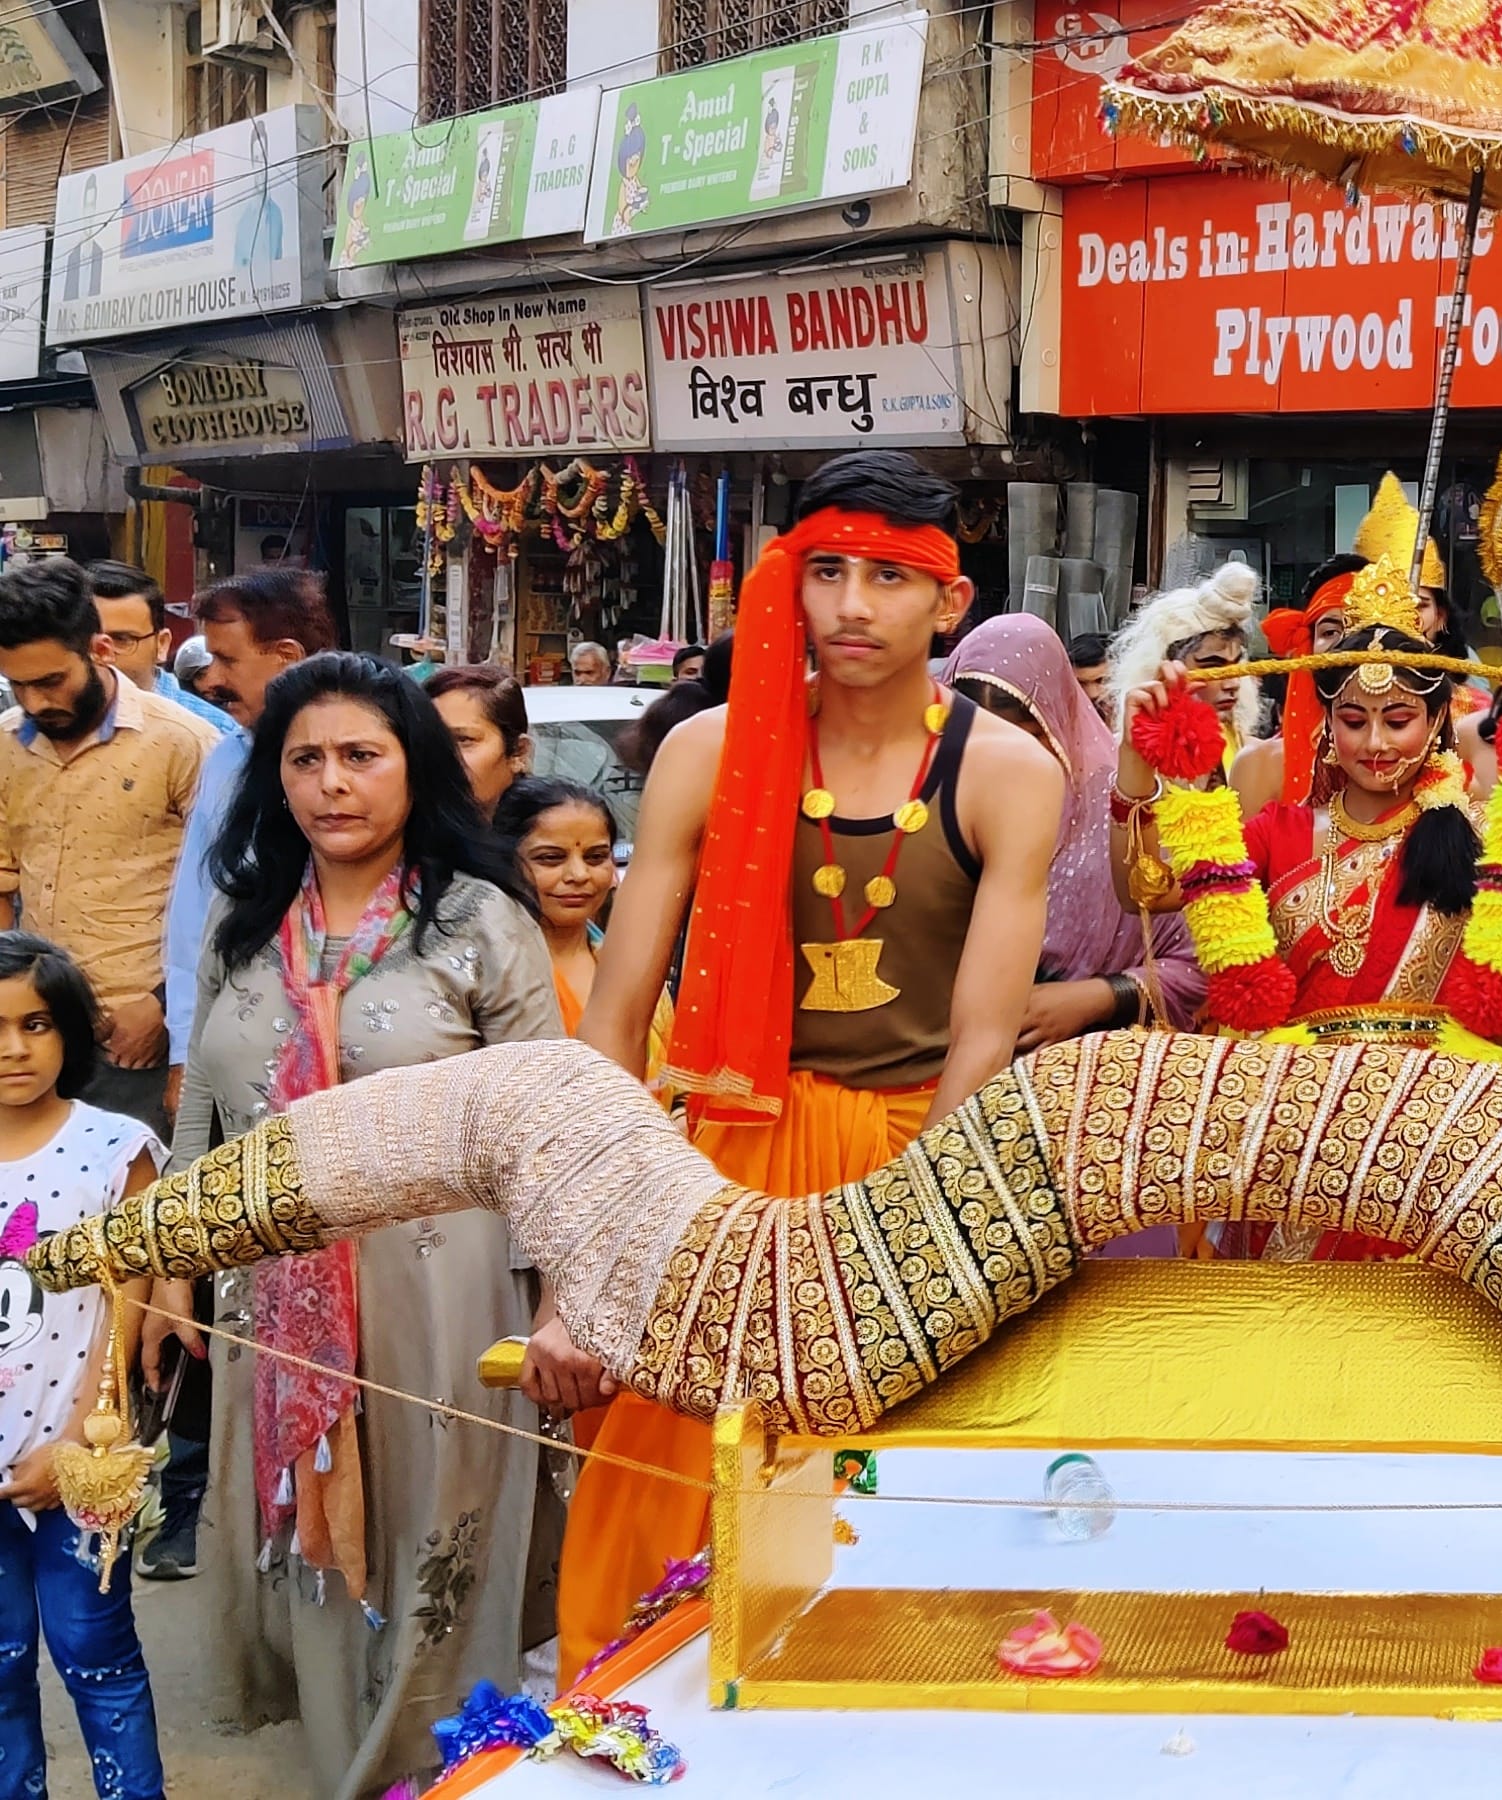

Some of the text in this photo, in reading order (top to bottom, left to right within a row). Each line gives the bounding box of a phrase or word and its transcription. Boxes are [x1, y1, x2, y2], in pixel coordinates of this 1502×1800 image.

[861, 40, 885, 67] R K
[679, 82, 736, 128] Amul
[847, 73, 890, 104] GUPTA
[859, 111, 868, 135] &
[534, 165, 585, 193] TRADERS
[842, 144, 878, 173] SONS
[138, 165, 210, 242] DONEAR
[1077, 226, 1188, 287] Deals
[83, 297, 135, 330] BOMBAY
[138, 284, 182, 322] CLOTH
[187, 276, 237, 316] HOUSE
[439, 308, 461, 328] Old
[463, 306, 495, 327] Shop
[514, 302, 544, 320] New
[547, 297, 587, 316] Name
[656, 279, 929, 361] VISHWA BANDHU
[431, 330, 496, 378] विशवास
[535, 329, 574, 369] सत्य
[581, 321, 603, 365] भी
[1212, 298, 1414, 385] Plywood
[159, 357, 268, 407] BOMBAY
[688, 365, 878, 433] विश्व बन्धु
[152, 400, 309, 445] CLOTH HOUSE
[405, 368, 649, 451] R.G. TRADERS
